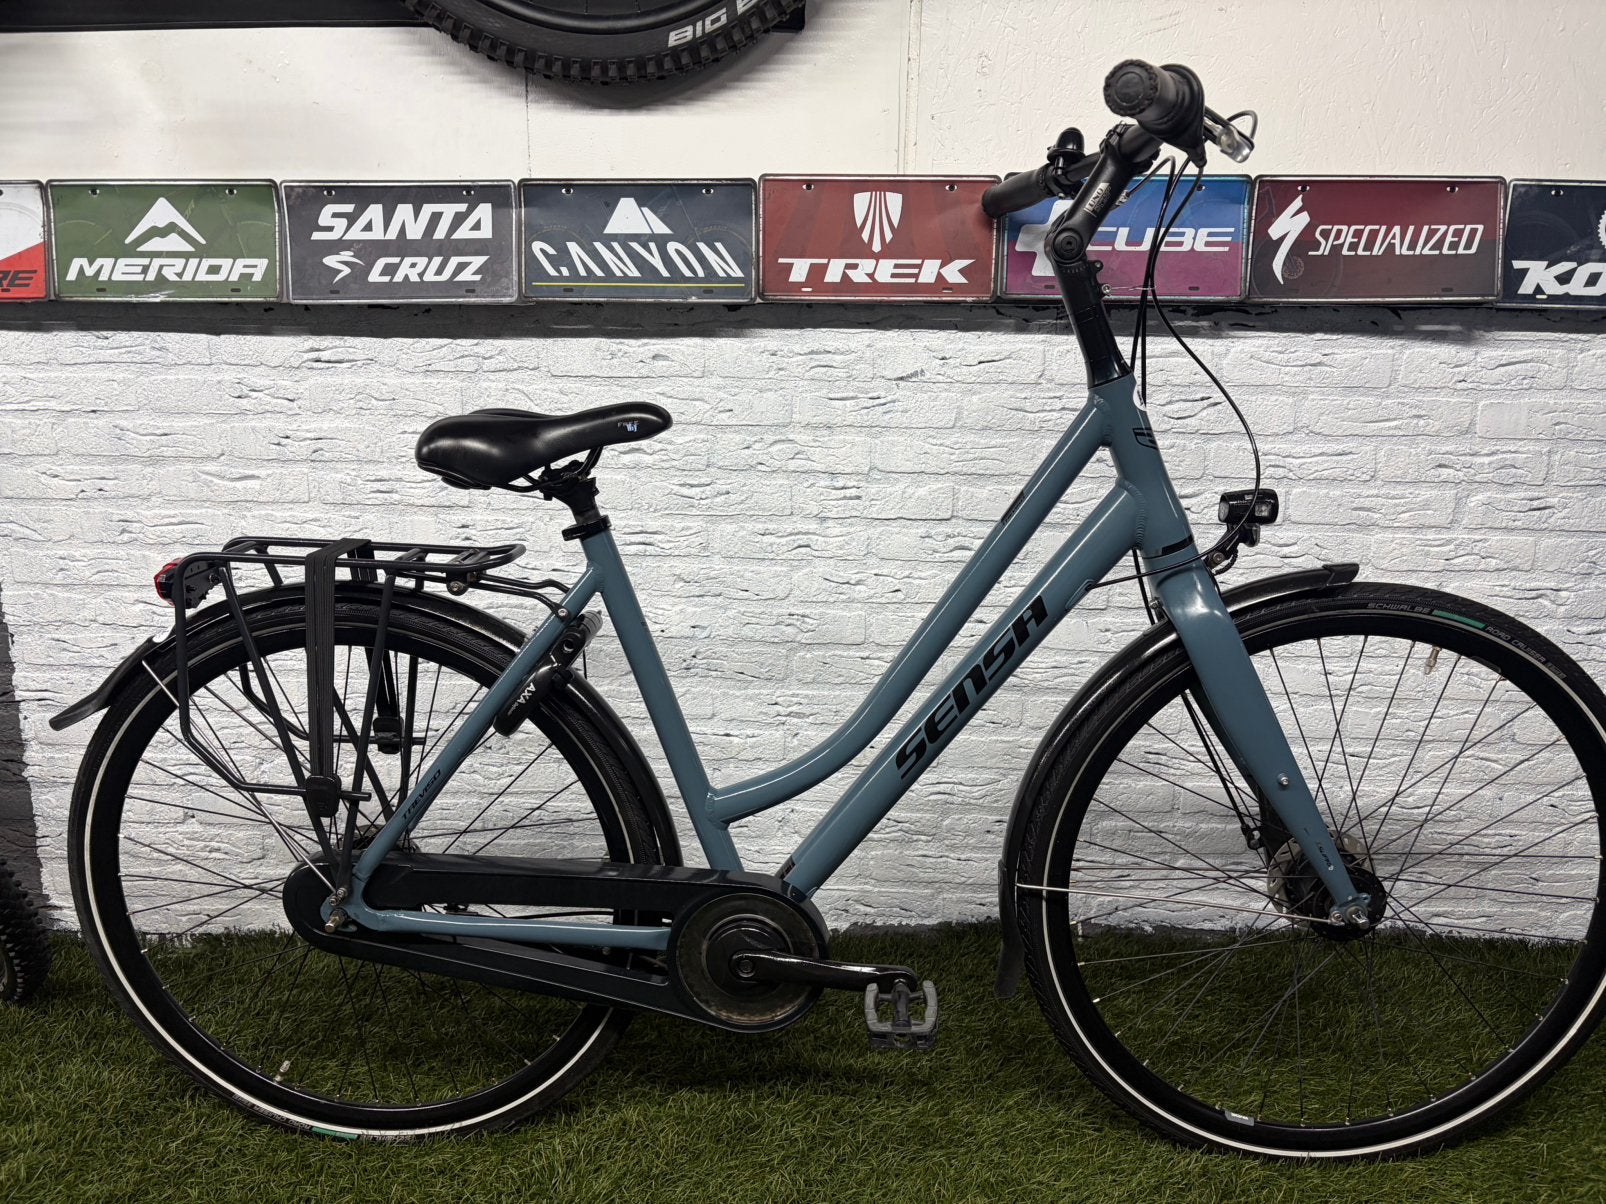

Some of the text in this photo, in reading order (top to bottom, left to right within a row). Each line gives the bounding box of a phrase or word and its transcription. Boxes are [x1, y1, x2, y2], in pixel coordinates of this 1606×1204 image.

[668, 7, 728, 48] BIG
[1088, 187, 1104, 209] UNO
[310, 202, 494, 241] SANTA
[1086, 227, 1235, 252] CUBE
[1307, 224, 1485, 256] SPECIALIZED
[66, 257, 269, 282] MERIDA
[367, 255, 491, 283] CRUZ
[531, 241, 745, 278] CANYON
[777, 258, 976, 284] TREK
[1366, 602, 1431, 614] SCHWALBE
[516, 682, 536, 704] AXA
[895, 595, 1049, 780] SENSA
